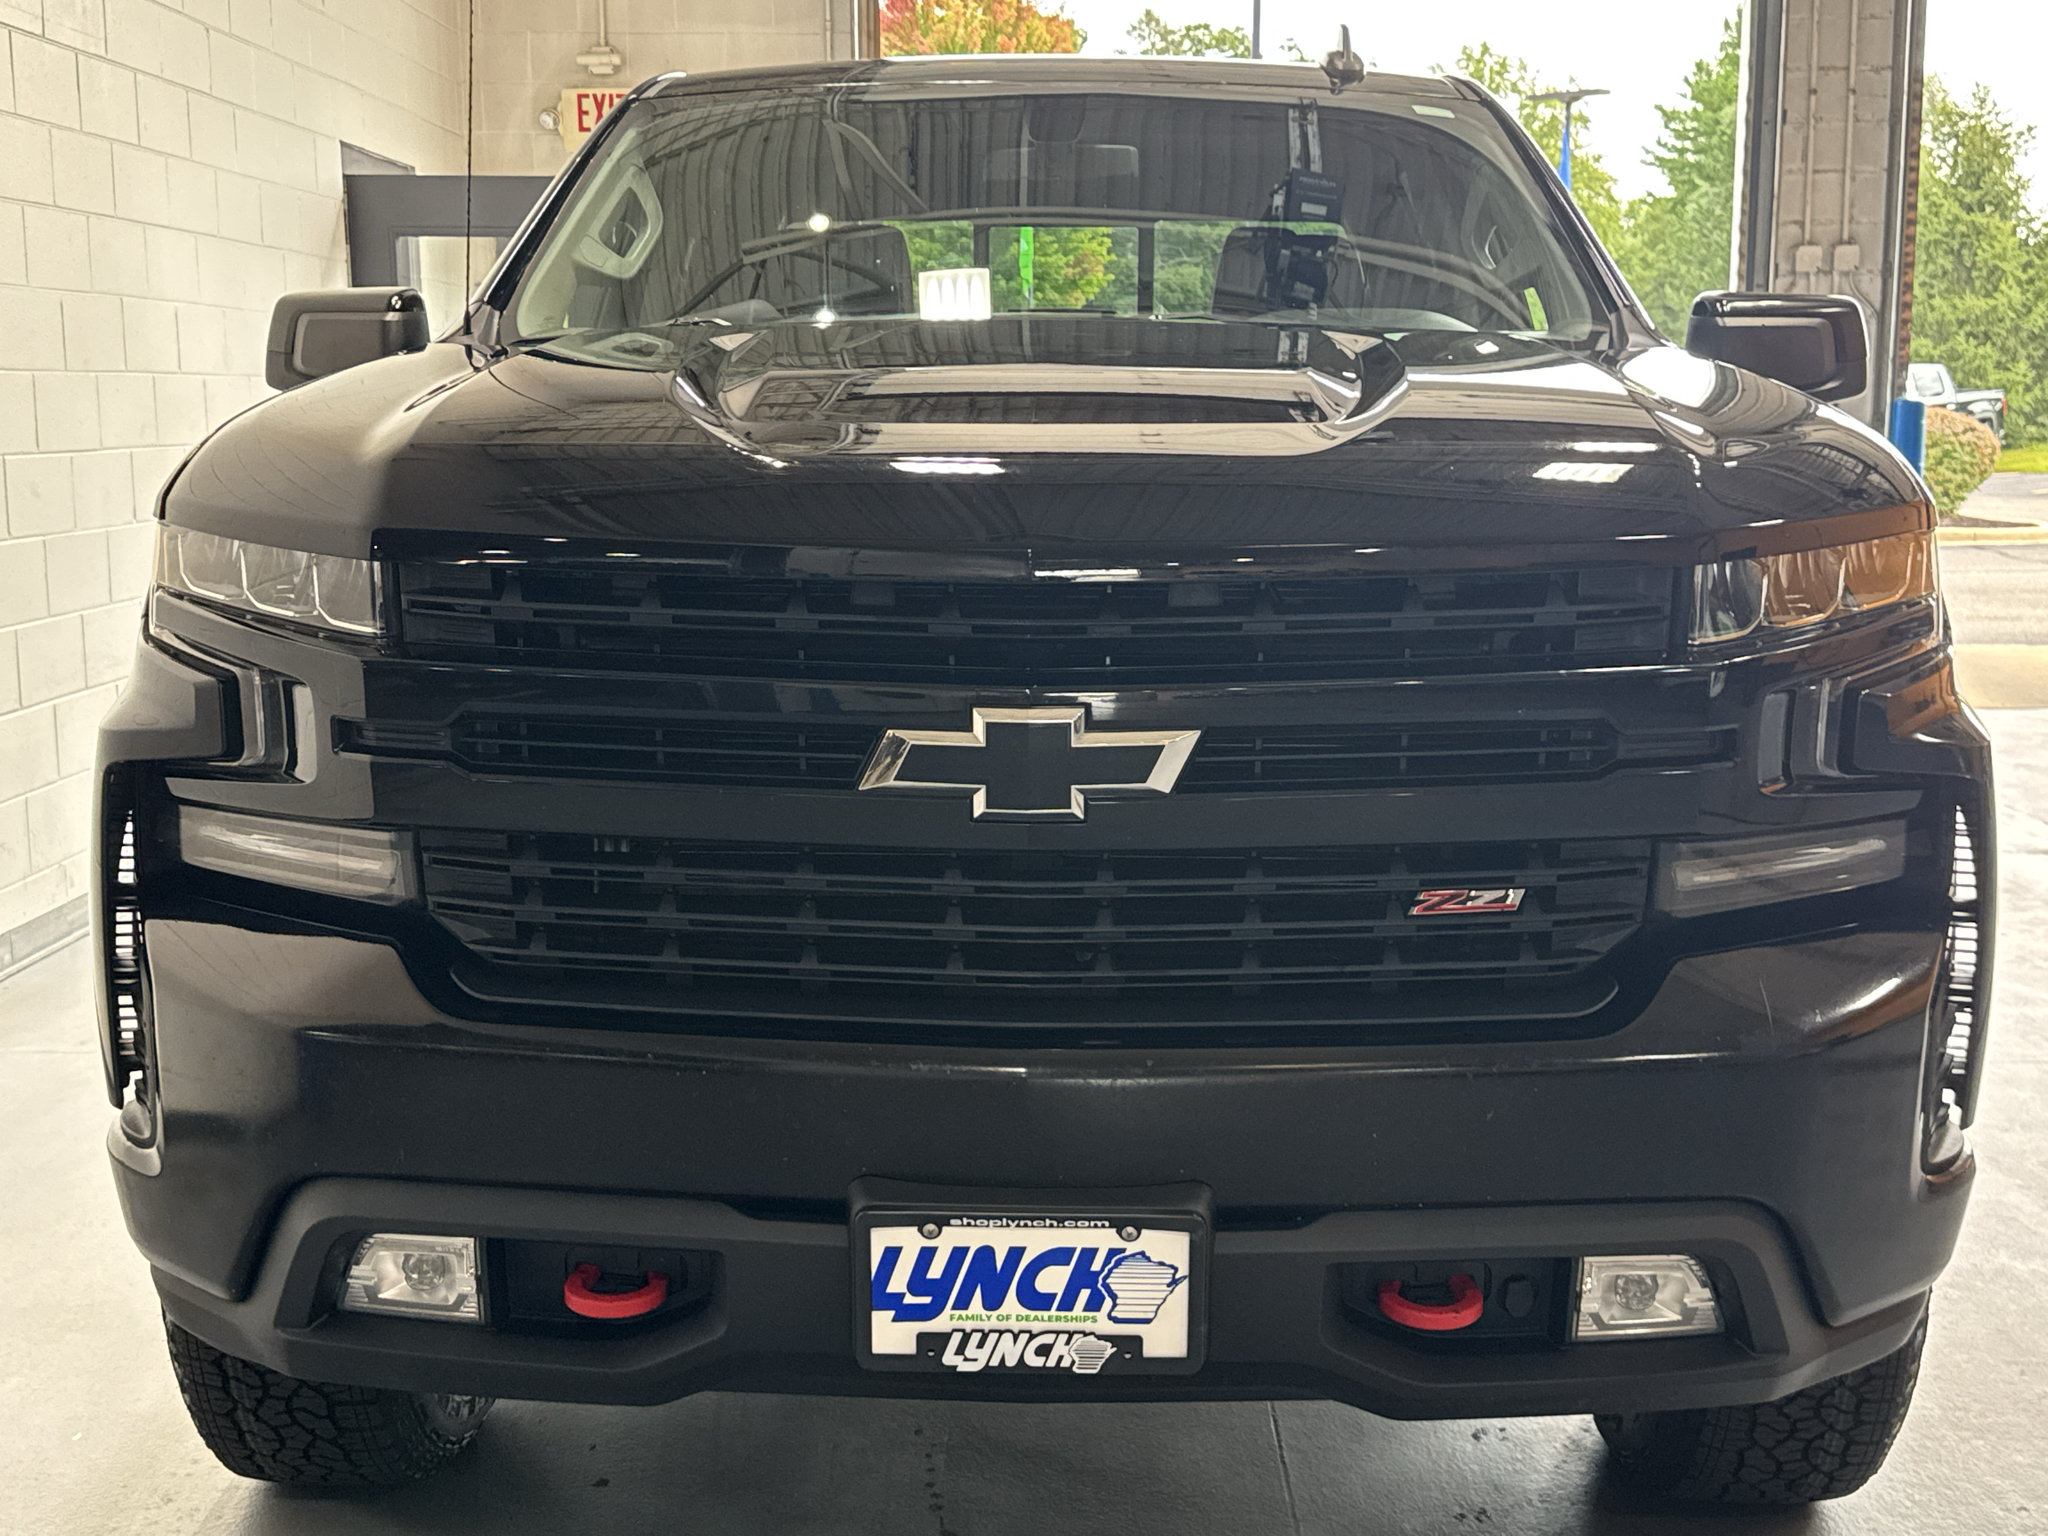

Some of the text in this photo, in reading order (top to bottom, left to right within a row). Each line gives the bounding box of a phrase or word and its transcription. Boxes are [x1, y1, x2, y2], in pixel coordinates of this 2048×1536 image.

[577, 94, 626, 132] EX
[1408, 889, 1525, 915] Z71
[949, 1217, 1110, 1229] shoplynch.com
[872, 1245, 1126, 1322] LYNCH
[949, 1313, 1098, 1323] FAMILY OF DEALERSHIPS
[941, 1330, 1084, 1372] LYNCH
